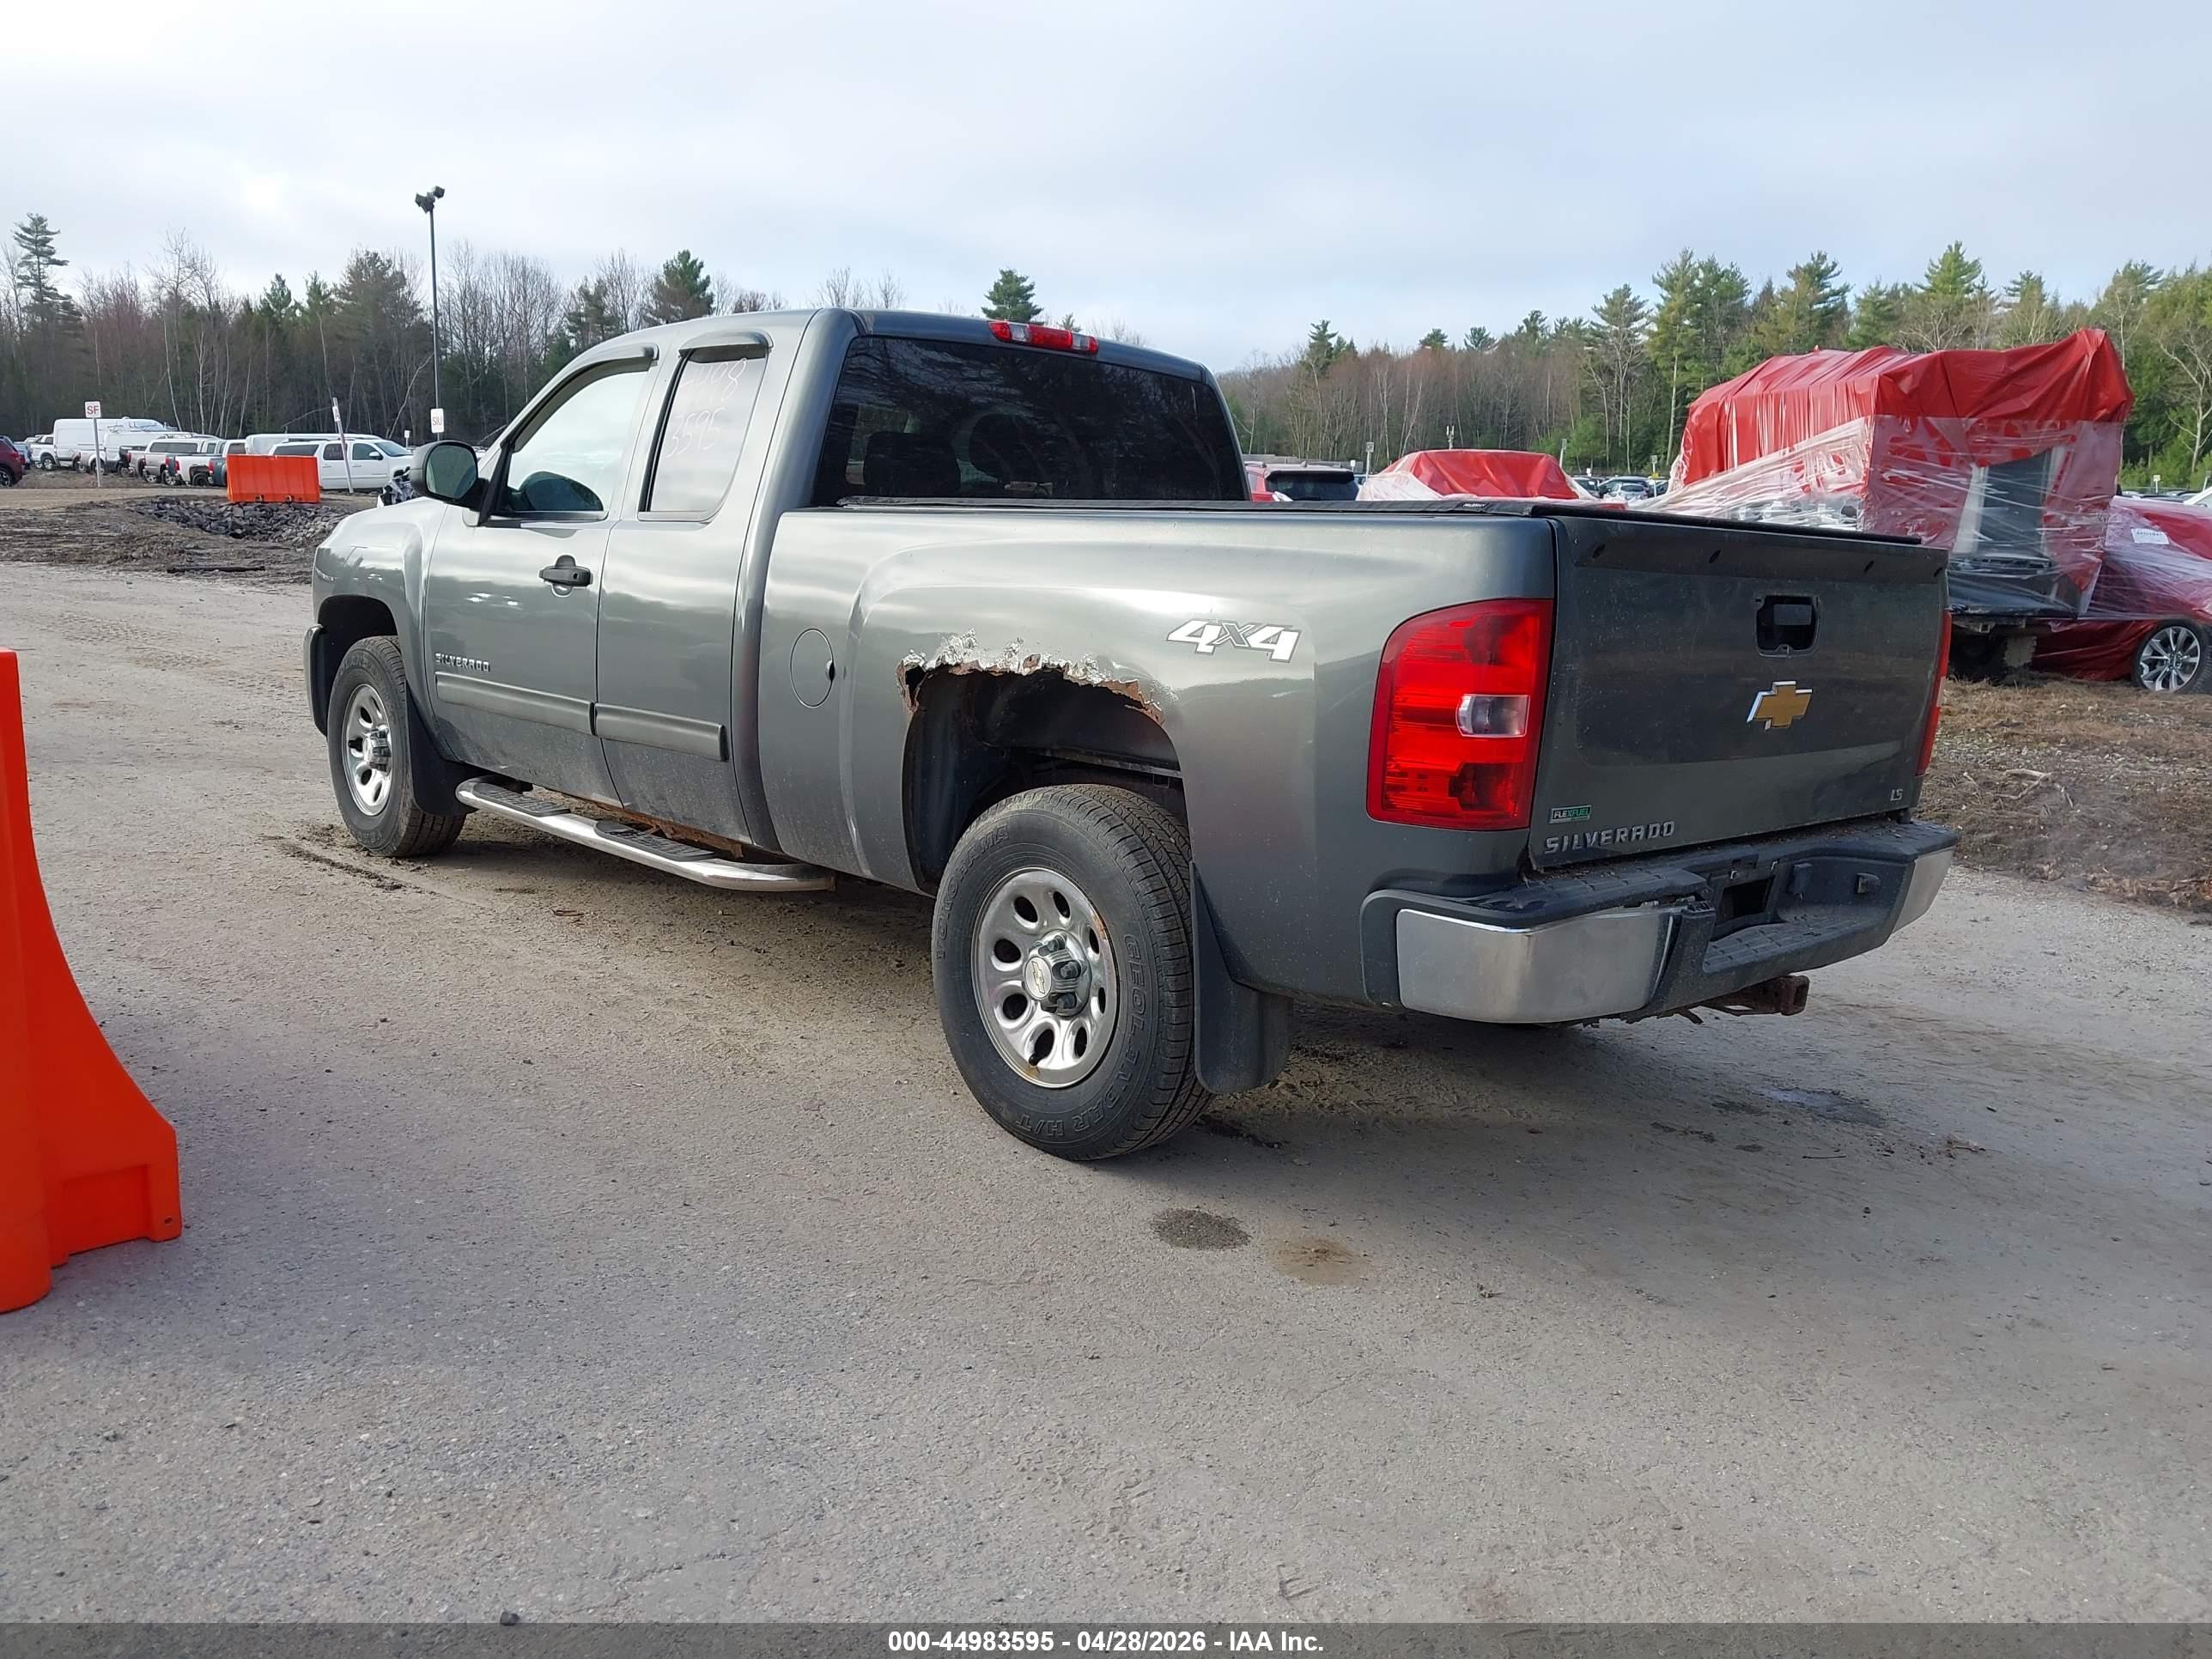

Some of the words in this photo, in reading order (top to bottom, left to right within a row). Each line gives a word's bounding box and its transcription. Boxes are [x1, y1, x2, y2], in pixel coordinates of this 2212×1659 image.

[87, 405, 100, 415] SF
[665, 406, 726, 459] 3595
[434, 653, 489, 672] SILVERADO
[1889, 788, 1904, 802] LS
[1544, 820, 1675, 854] SILVERADO
